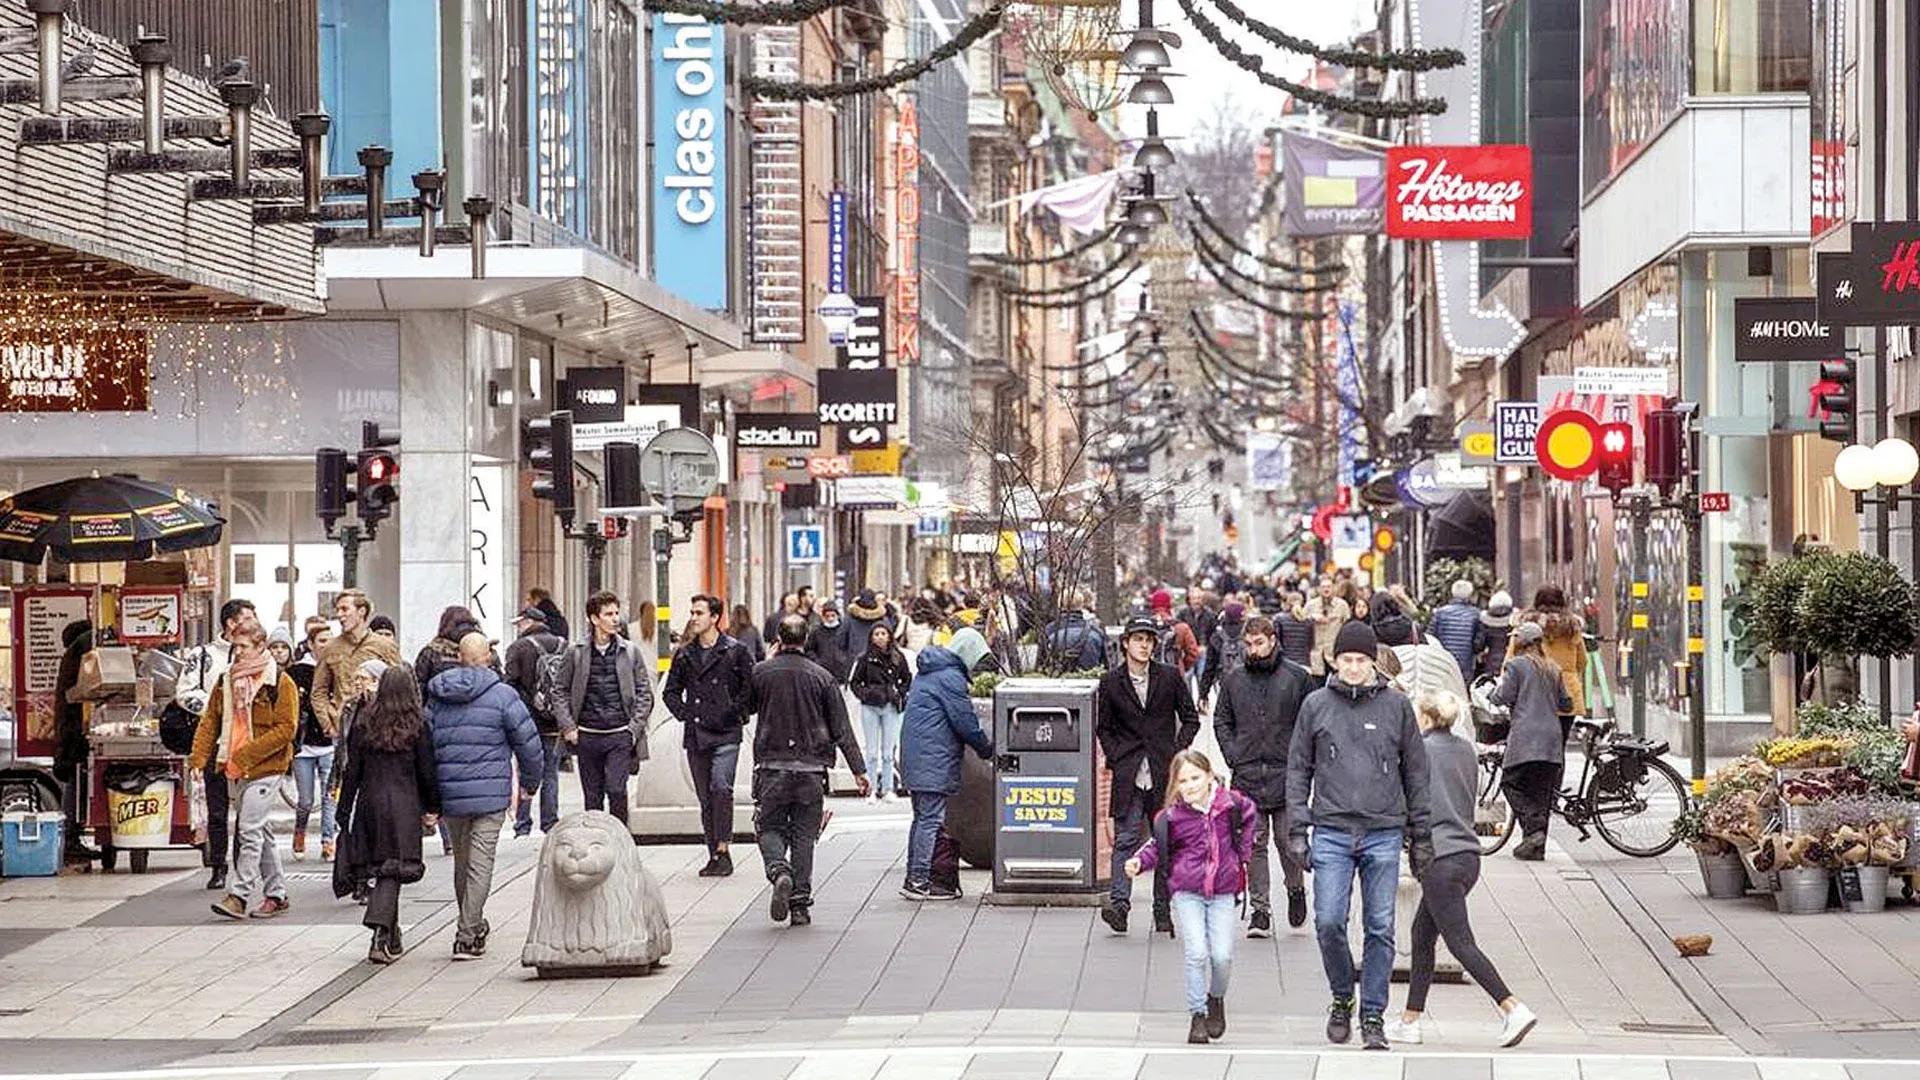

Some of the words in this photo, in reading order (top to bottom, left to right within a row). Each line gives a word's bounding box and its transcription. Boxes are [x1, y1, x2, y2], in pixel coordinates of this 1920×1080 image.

[664, 107, 715, 225] clas
[1396, 158, 1525, 206] Hötorgs
[1402, 203, 1516, 222] PASSAGEN
[897, 100, 919, 360] APOTEK
[1774, 320, 1830, 338] HOME
[1, 342, 85, 380] MUJI
[819, 402, 896, 423] SCORETT
[737, 426, 818, 446] stadium
[1005, 787, 1076, 806] JESUS
[118, 798, 159, 823] MER
[1014, 807, 1068, 821] SAVES
